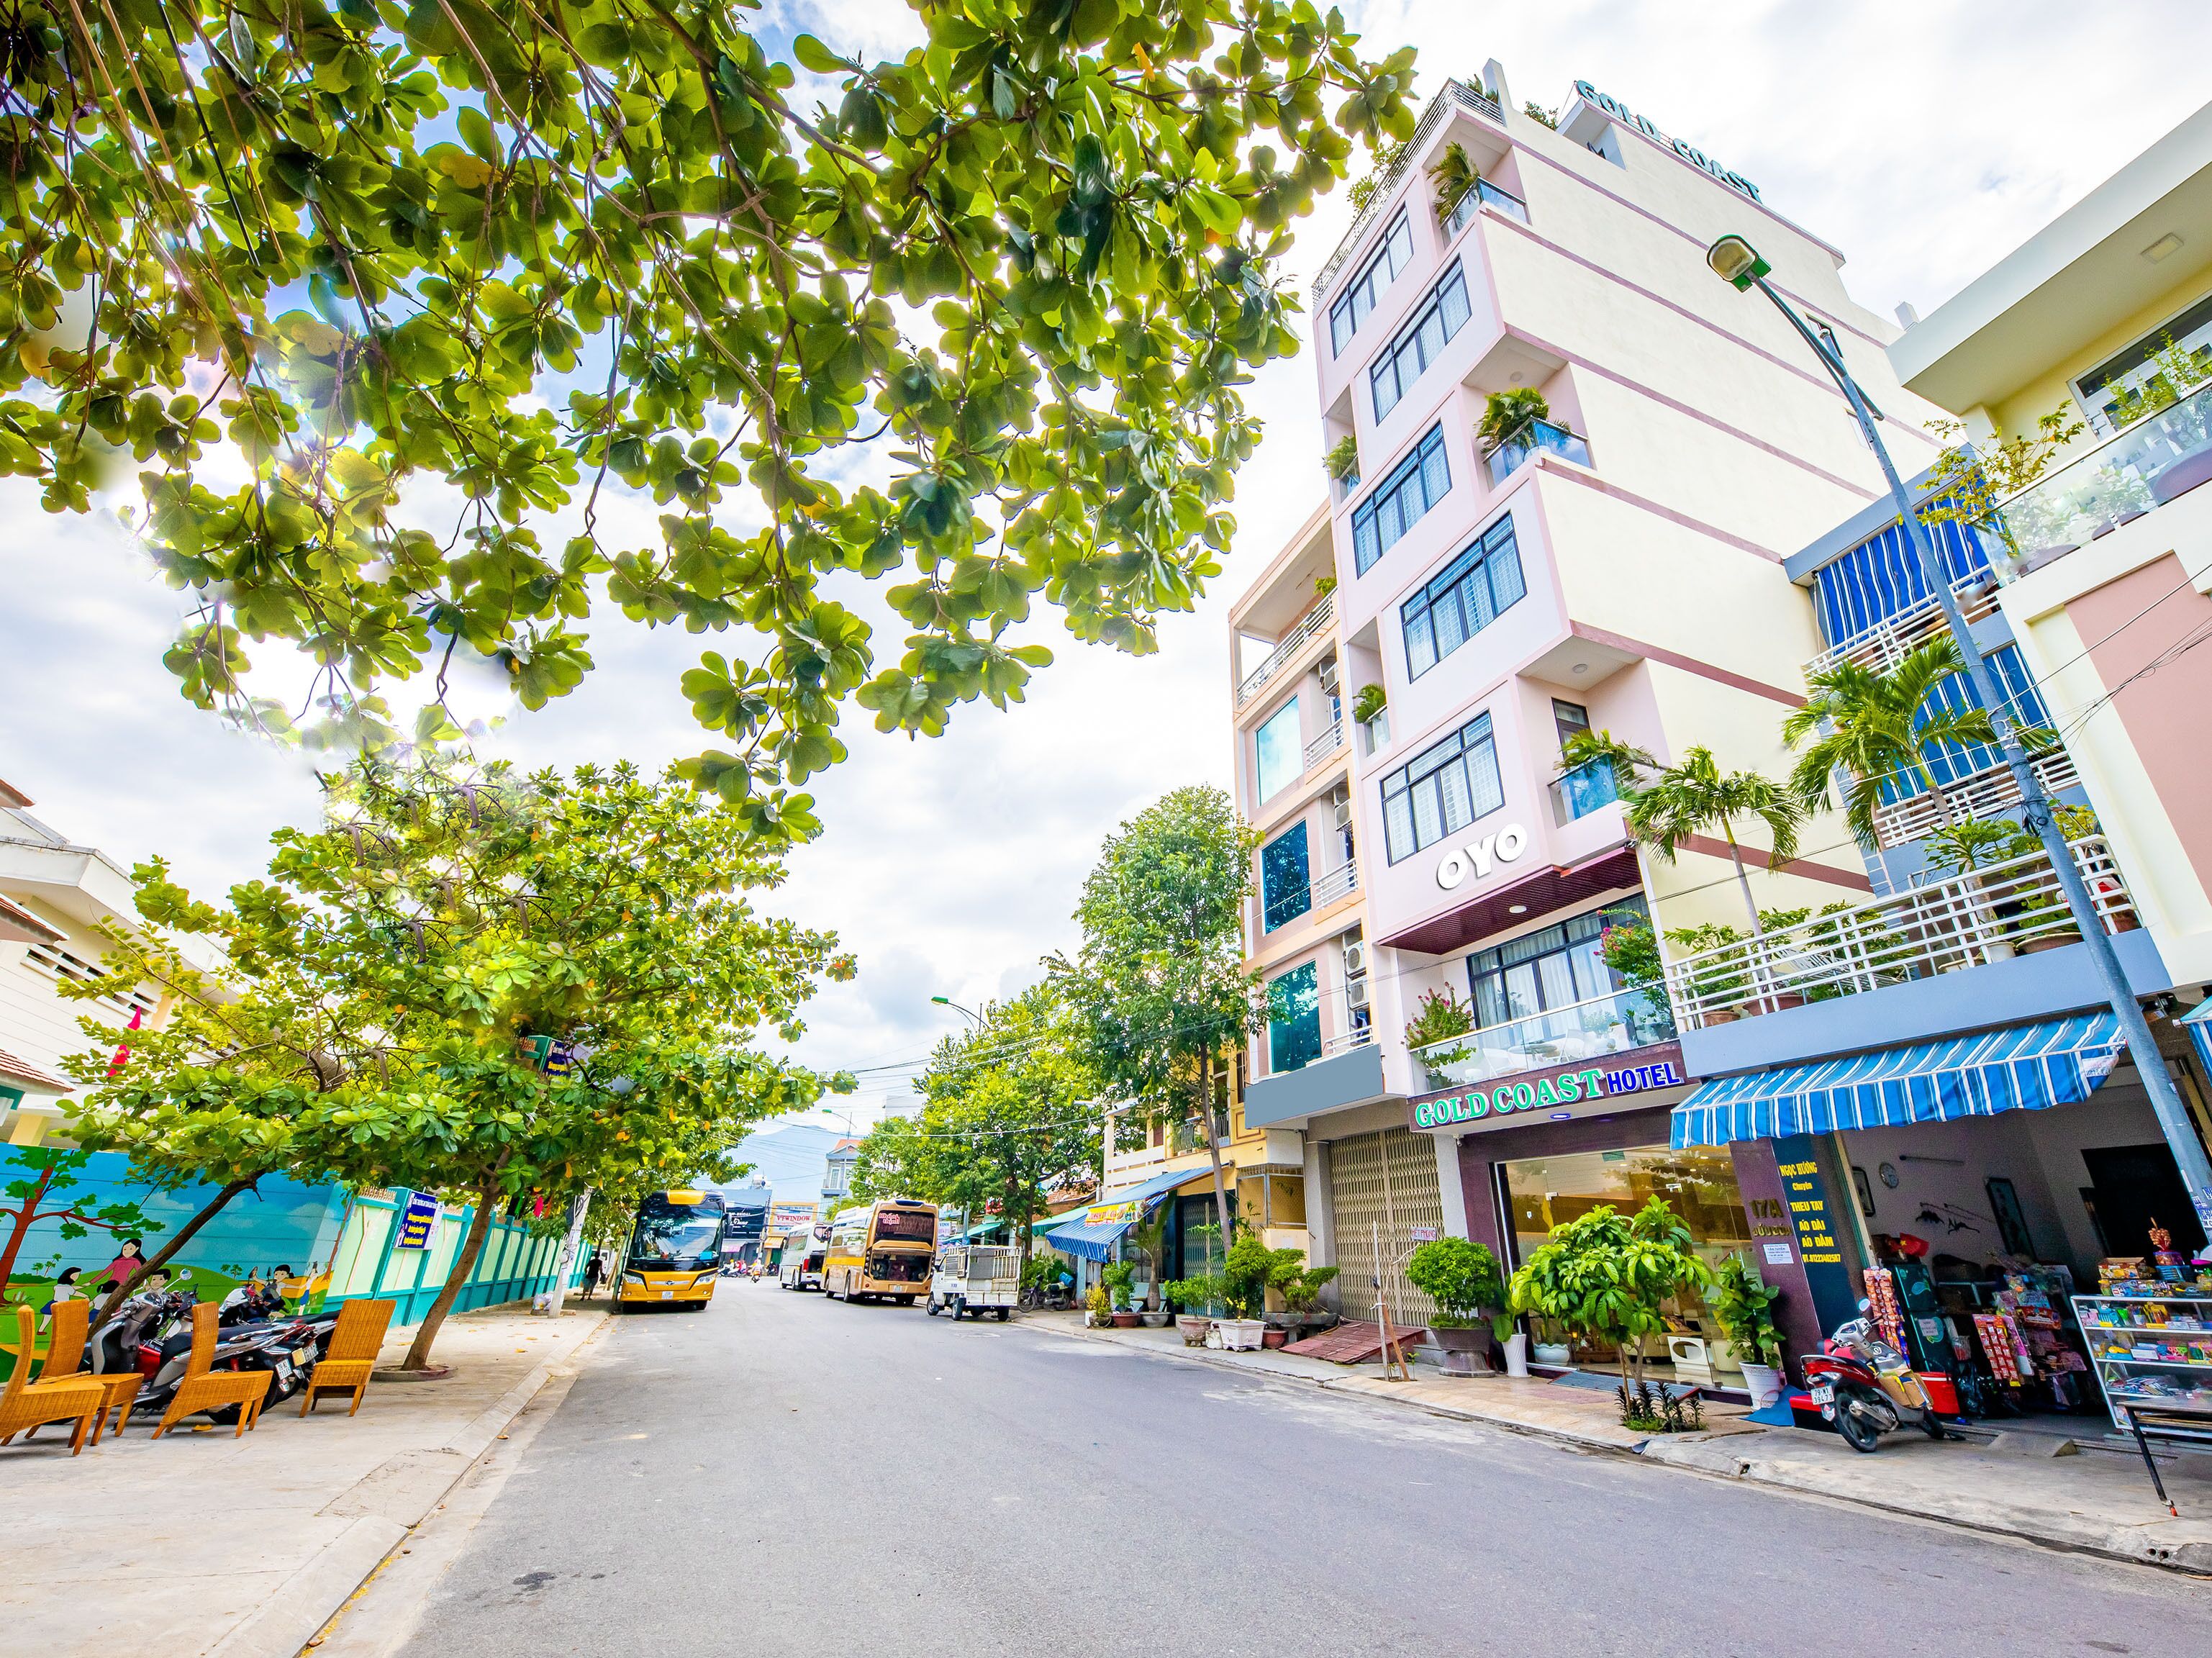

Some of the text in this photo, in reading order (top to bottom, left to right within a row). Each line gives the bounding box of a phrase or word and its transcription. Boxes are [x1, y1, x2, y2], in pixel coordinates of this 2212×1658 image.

[1575, 79, 1762, 204] GOLD COAST
[1437, 823, 1528, 890] OYO
[1415, 1061, 1682, 1128] GOLD COAST HOTEL
[1779, 1164, 1797, 1178] NGỌC
[1750, 1199, 1784, 1218] 17A
[1810, 1200, 1823, 1211] TAY
[1799, 1219, 1810, 1231] ÁO
[1802, 1235, 1813, 1247] ÁO
